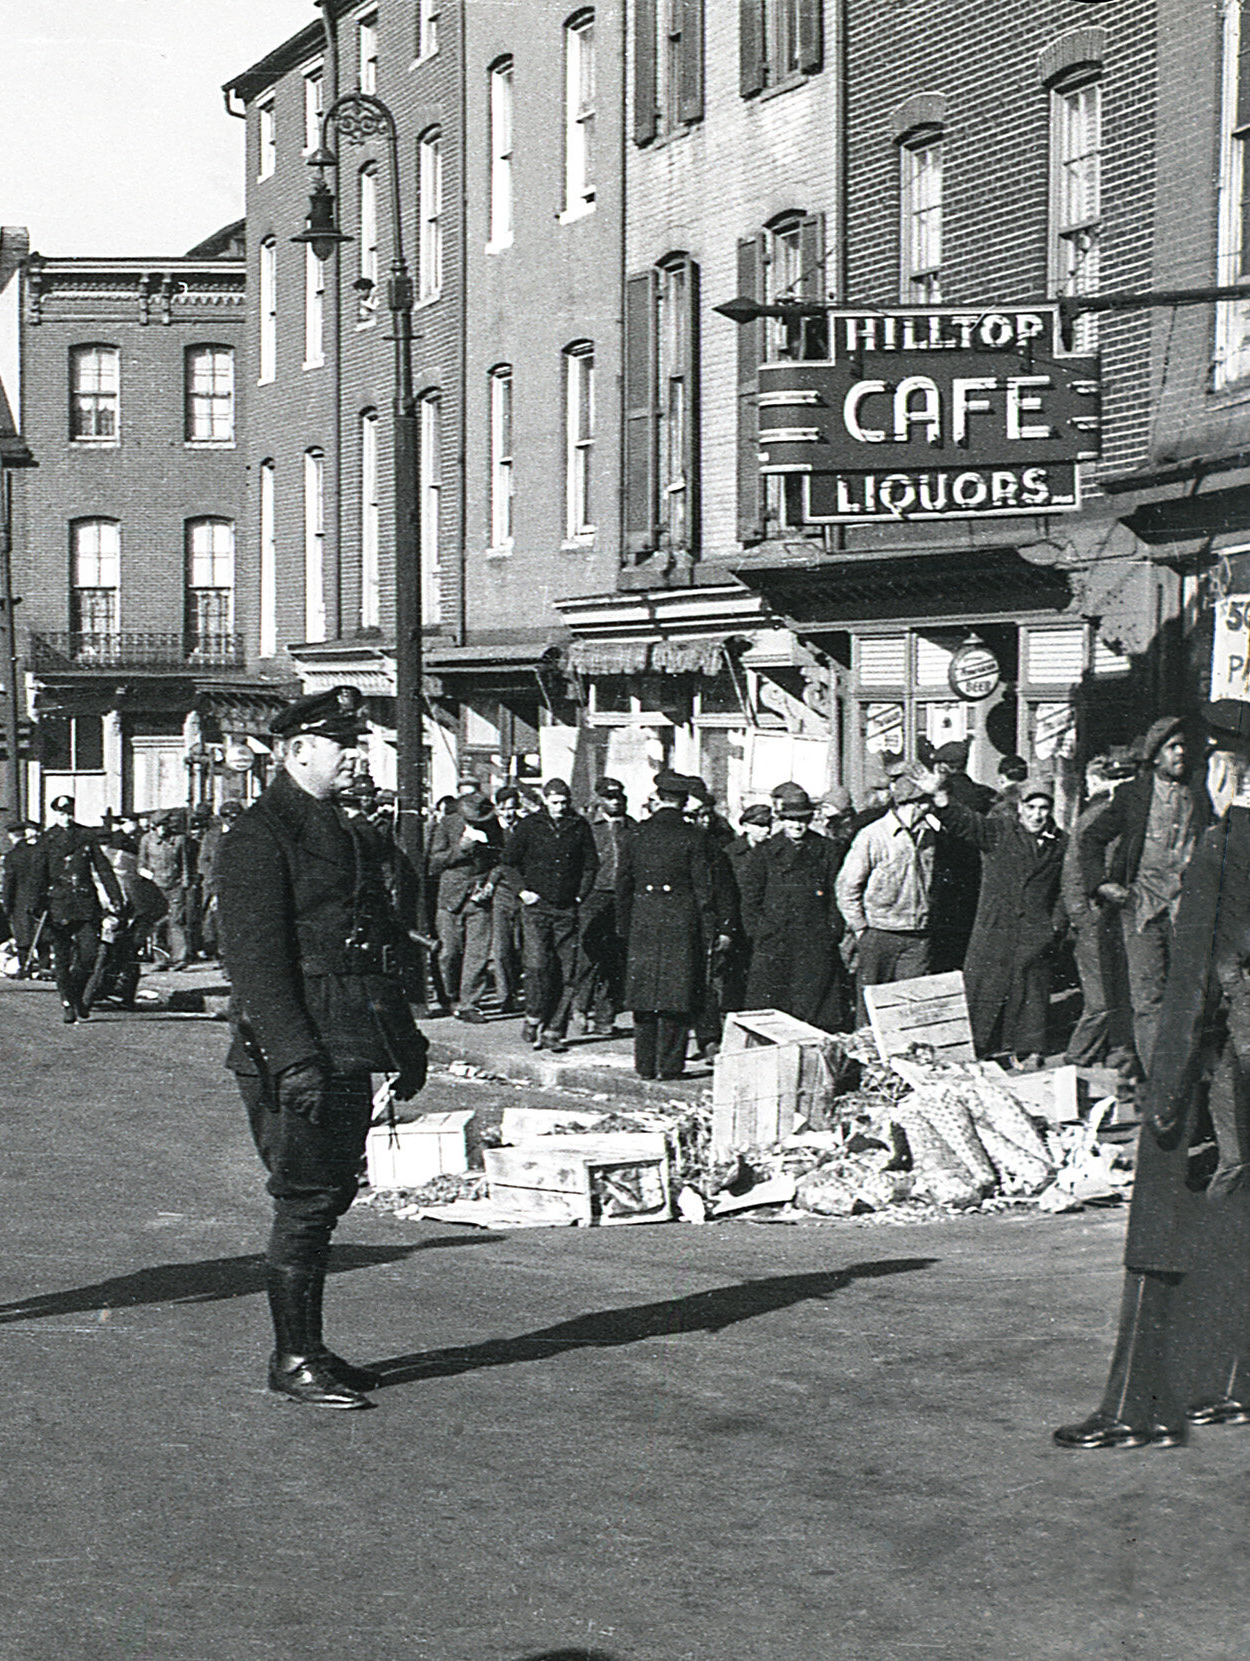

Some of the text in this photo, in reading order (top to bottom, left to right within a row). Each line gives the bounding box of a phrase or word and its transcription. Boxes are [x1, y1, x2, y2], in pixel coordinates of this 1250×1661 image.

[846, 313, 1043, 351] HILLTOP
[843, 375, 1051, 443] CAFE
[837, 467, 1050, 517] LIQUORS
